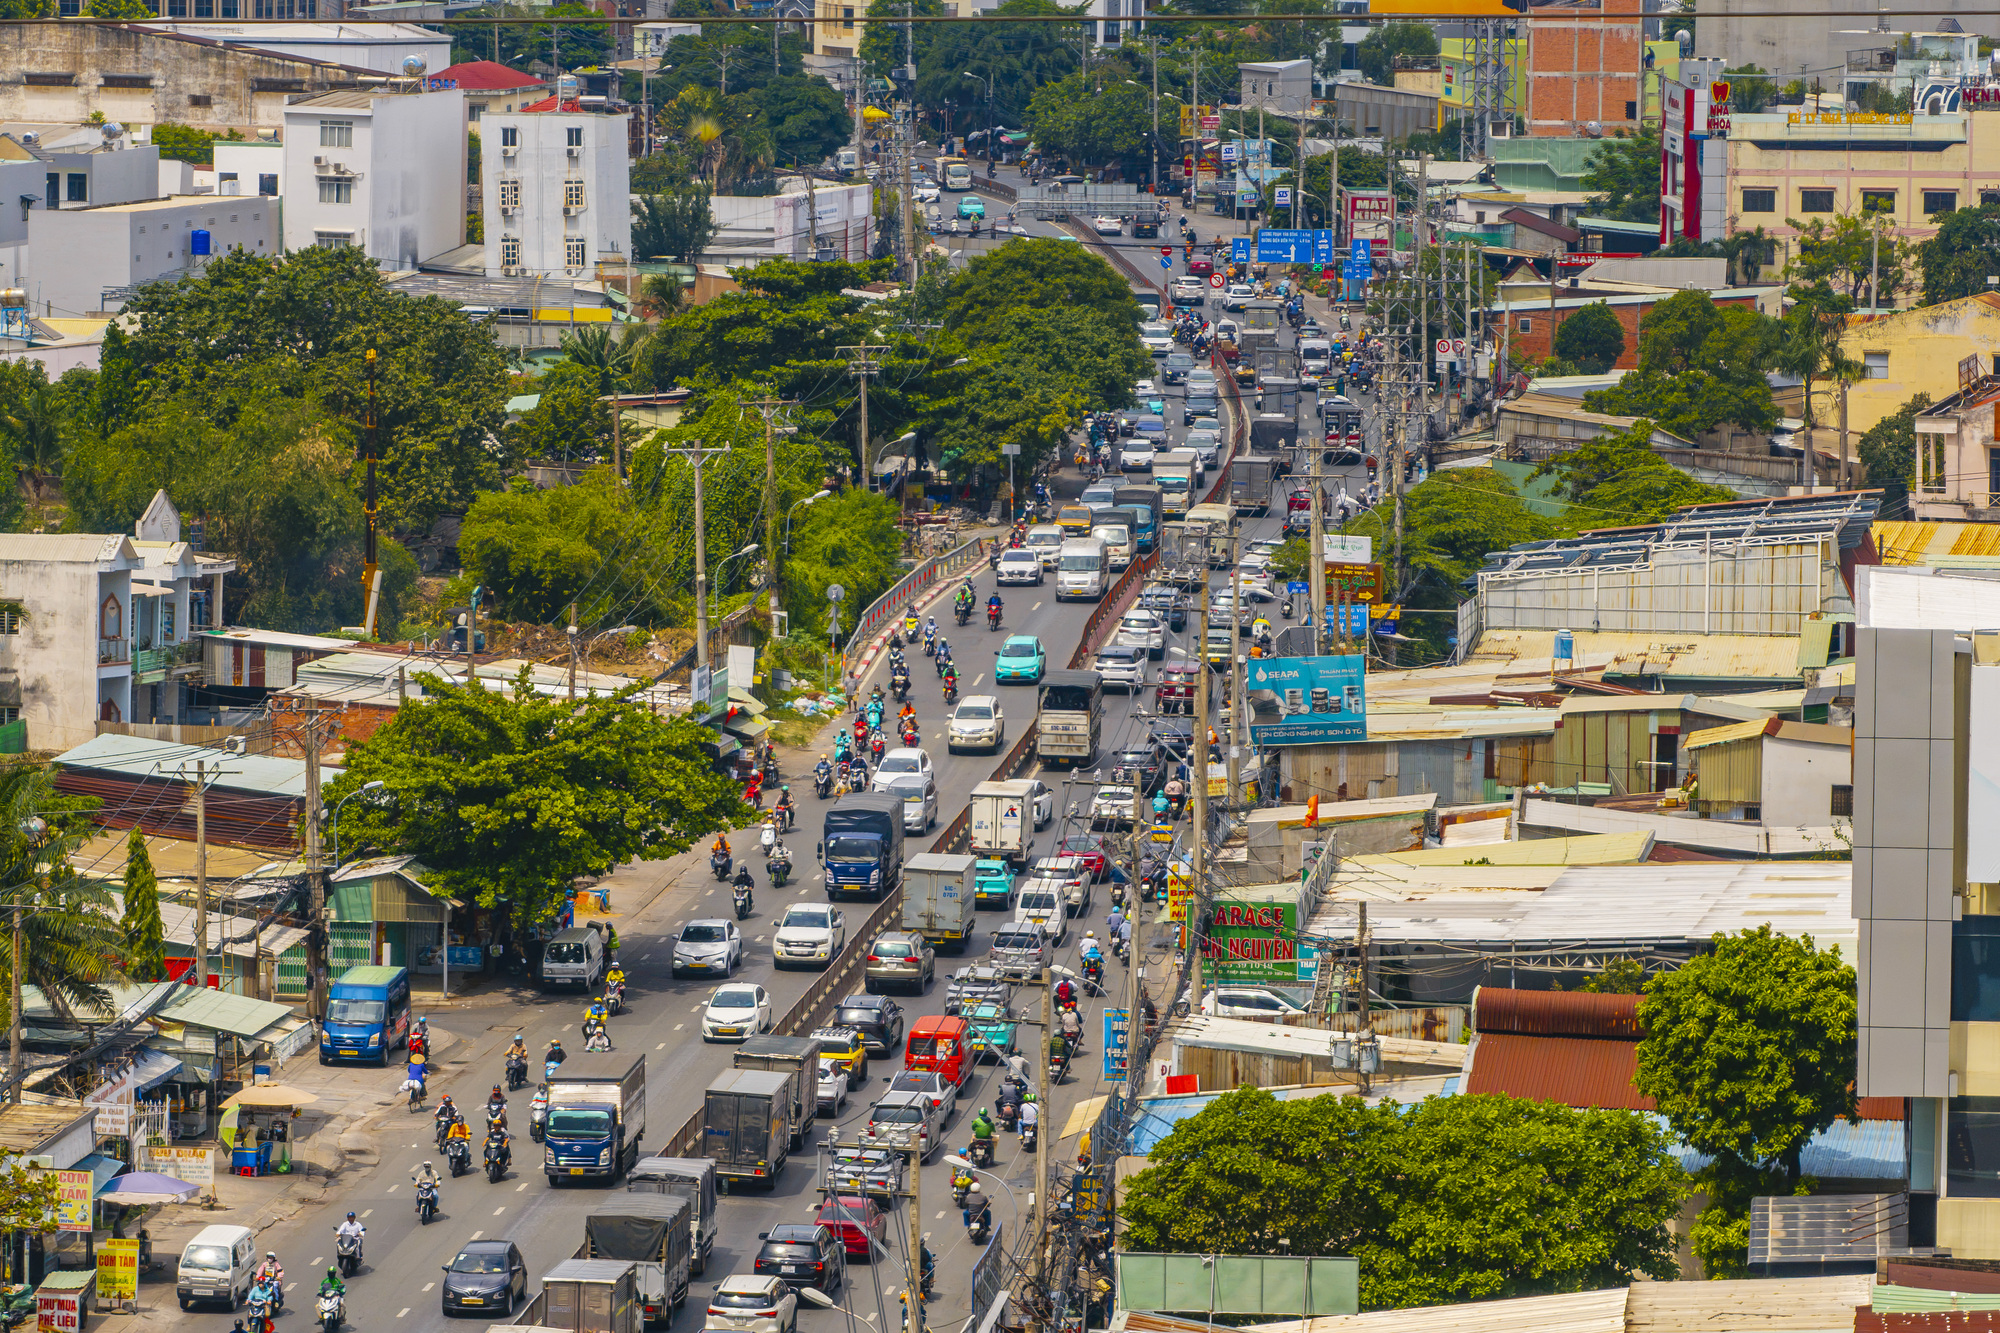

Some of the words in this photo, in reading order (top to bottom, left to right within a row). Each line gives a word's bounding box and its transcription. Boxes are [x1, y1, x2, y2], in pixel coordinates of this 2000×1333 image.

[1710, 104, 1729, 116] NHA
[1707, 118, 1731, 129] KHOA
[1268, 670, 1299, 679] SEAPA
[1214, 906, 1284, 927] ARAGE
[59, 1172, 88, 1184] CƠM
[60, 1185, 87, 1200] TẤM
[99, 1254, 116, 1266] CƠM
[39, 1298, 54, 1310] THU
[58, 1299, 76, 1311] MUA
[39, 1311, 56, 1326] PHẾ
[57, 1312, 76, 1330] LIỆU
